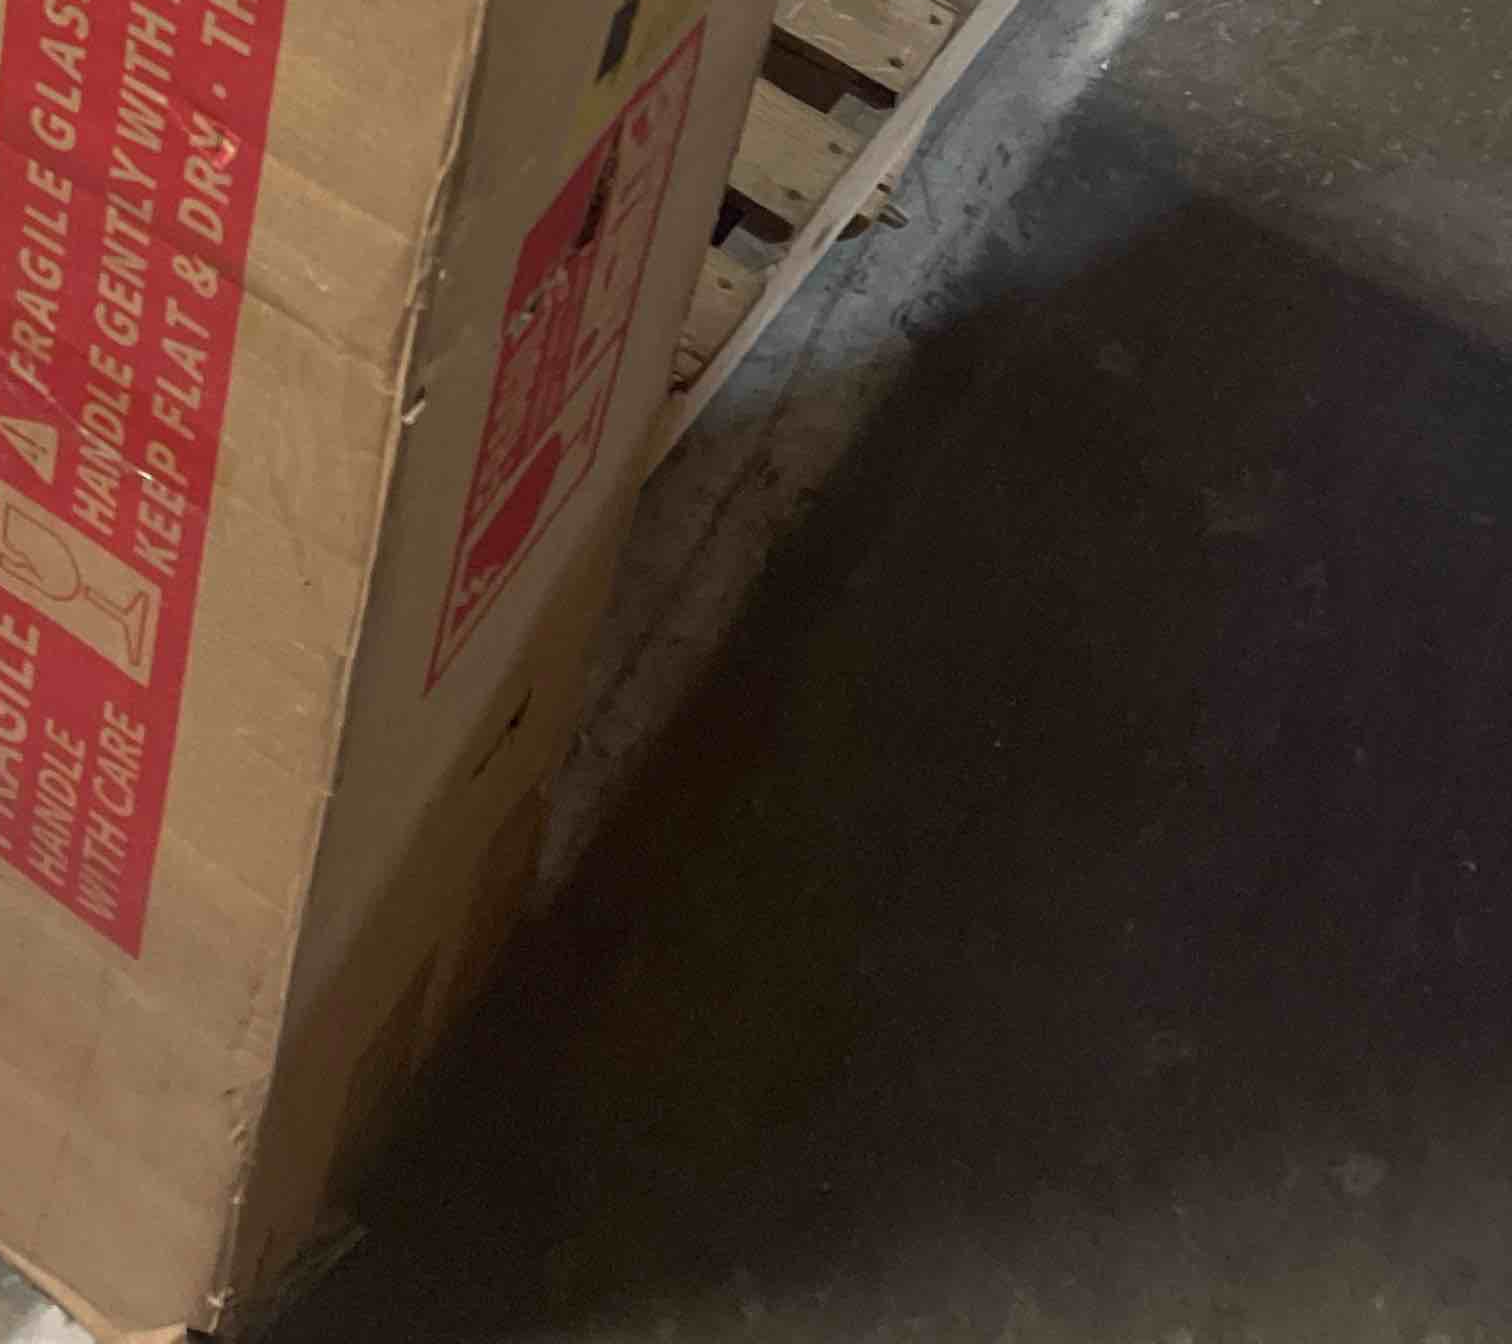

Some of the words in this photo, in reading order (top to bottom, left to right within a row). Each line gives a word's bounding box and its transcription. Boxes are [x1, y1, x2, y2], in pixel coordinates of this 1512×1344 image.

[116, 1, 178, 155] WITH
[91, 146, 158, 348] GENTLY
[177, 111, 234, 246] DRY
[8, 160, 74, 397] FRAGILE
[171, 251, 219, 300] &
[71, 345, 133, 535] HANDLE
[153, 296, 211, 440] FLAT
[131, 439, 191, 577] KEEP
[26, 717, 88, 888] HANDLE
[92, 701, 149, 819] CARE
[75, 807, 129, 922] WITH
